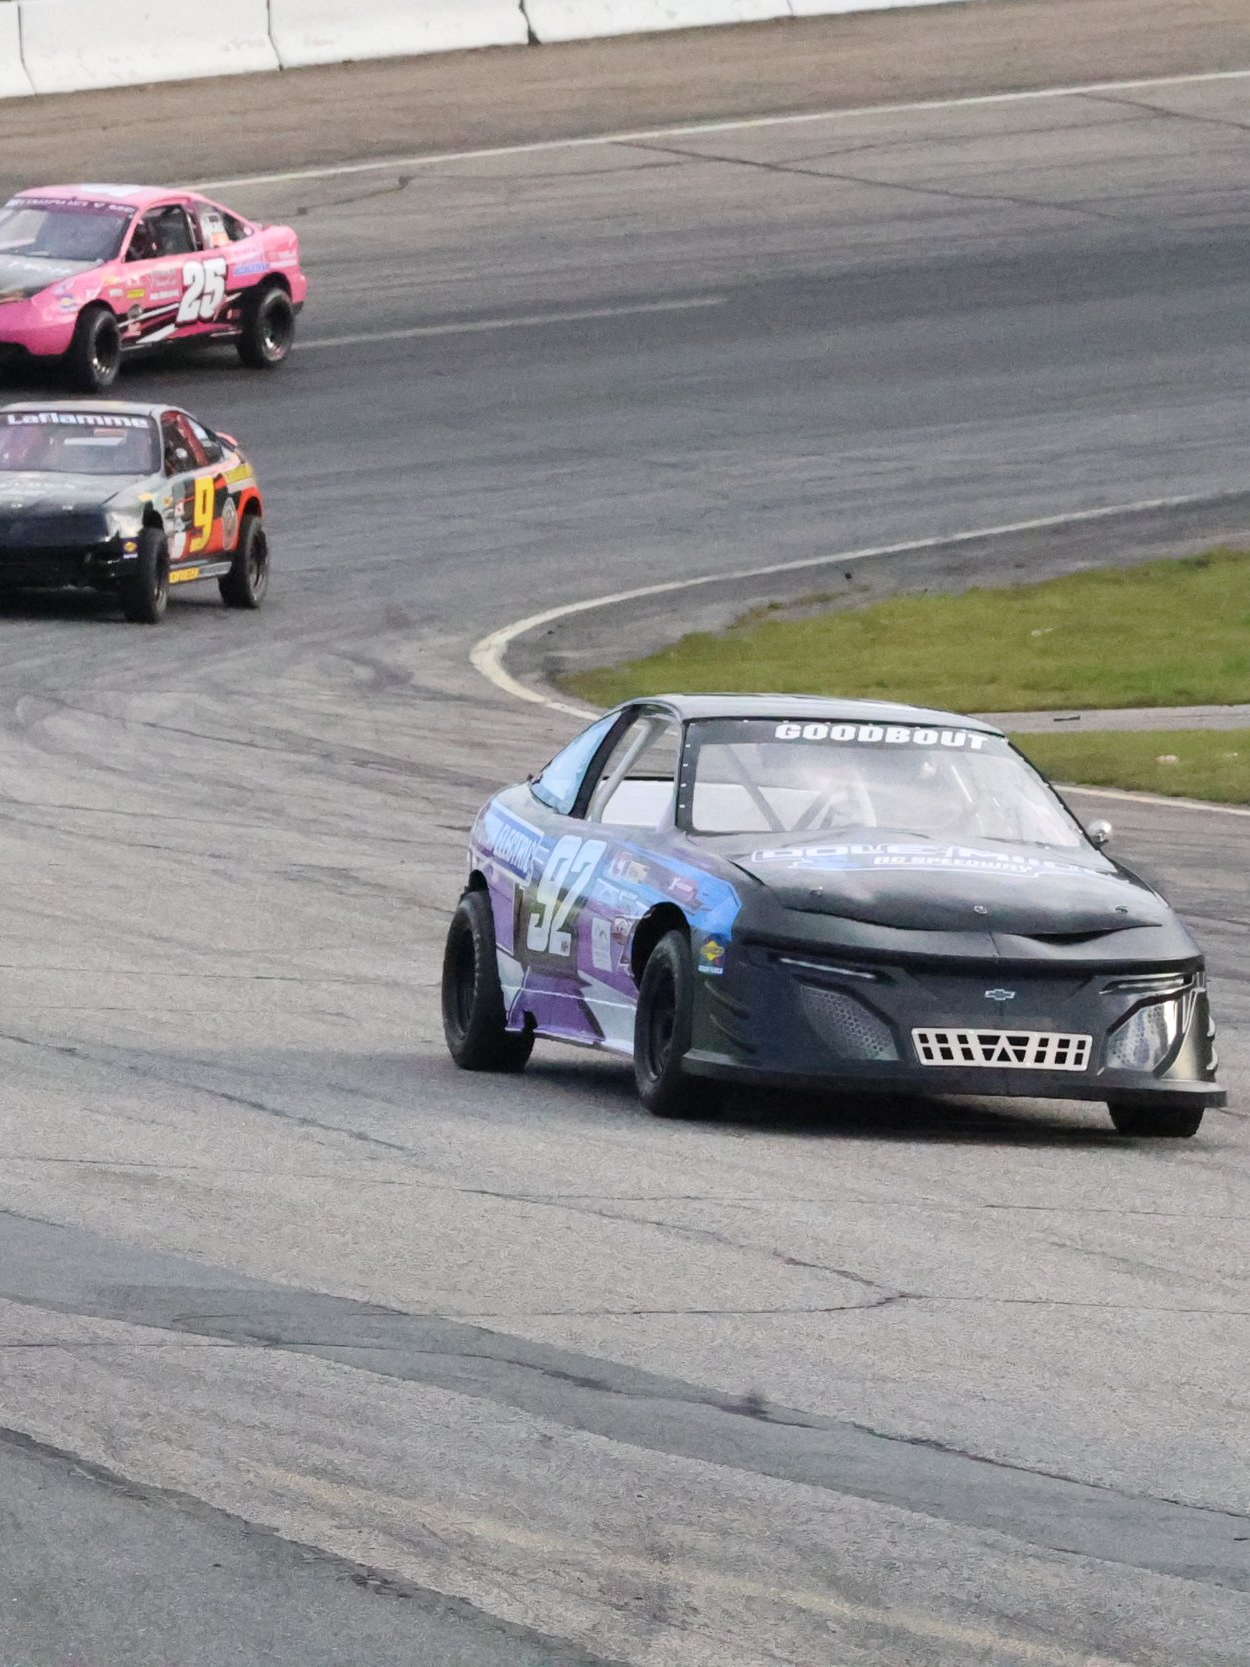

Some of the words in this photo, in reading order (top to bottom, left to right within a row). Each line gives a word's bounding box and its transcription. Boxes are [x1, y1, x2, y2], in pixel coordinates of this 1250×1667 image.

[176, 256, 227, 323] 25
[7, 413, 149, 428] Laflamme
[189, 477, 215, 553] 9
[775, 723, 988, 749] GOODBOUT
[910, 856, 1033, 873] SPEEDWAY
[527, 835, 607, 957] 92
